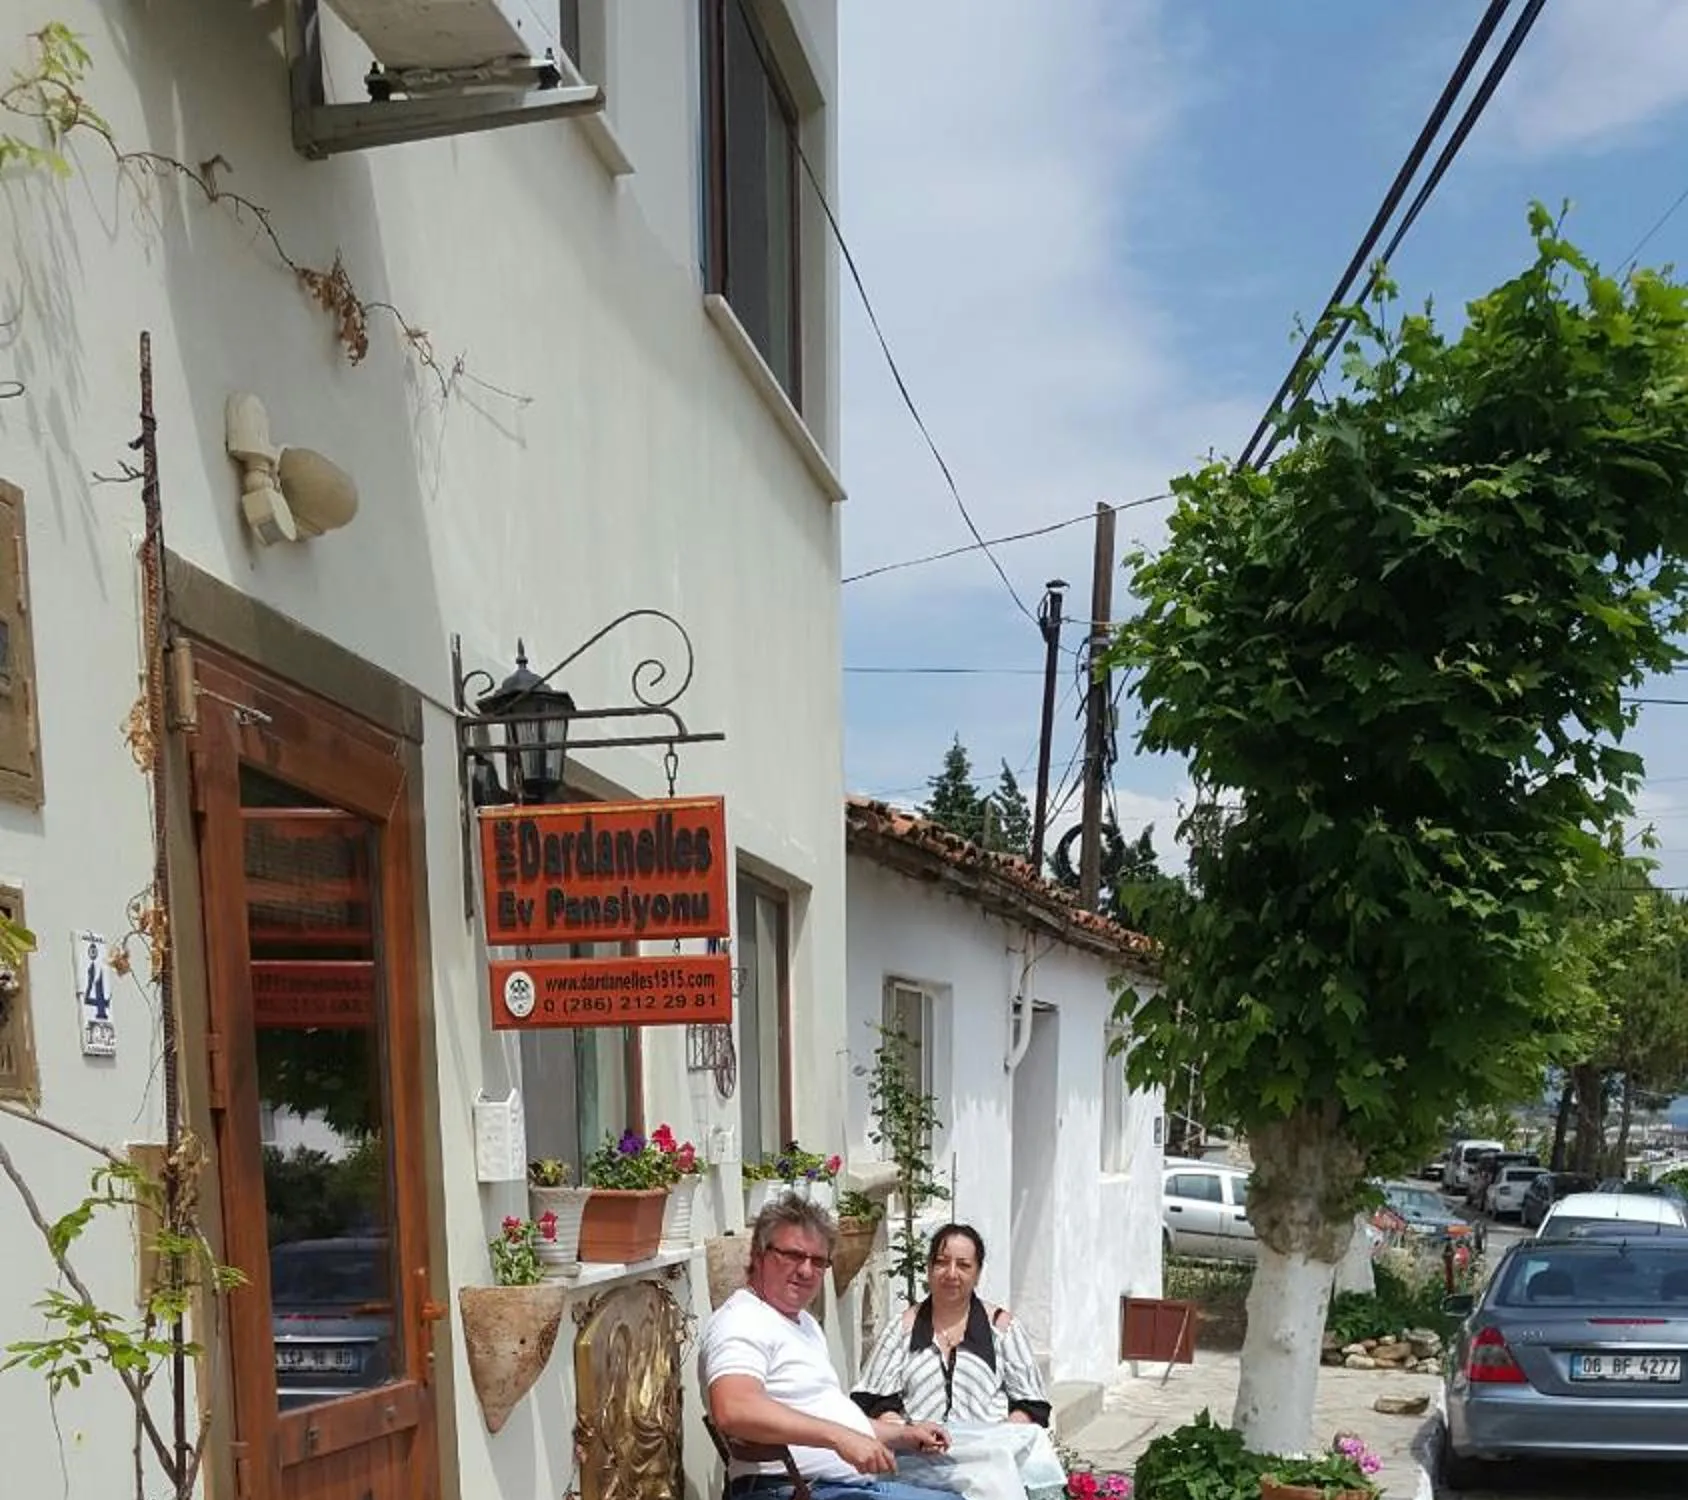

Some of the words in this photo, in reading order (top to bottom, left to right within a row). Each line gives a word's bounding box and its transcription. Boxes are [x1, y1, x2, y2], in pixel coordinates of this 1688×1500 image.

[518, 812, 712, 880] Dardanelles
[497, 891, 534, 932] Ev
[546, 886, 709, 935] Pansiyonu
[84, 961, 112, 1019] 4
[545, 969, 715, 993] www.dardanelles1915.com
[543, 999, 555, 1012] 0
[563, 996, 613, 1014] (286)
[621, 995, 656, 1010] 212
[664, 994, 687, 1009] 29
[694, 992, 717, 1008] 81
[1583, 1358, 1601, 1373] 06
[1639, 1358, 1679, 1375] 4277
